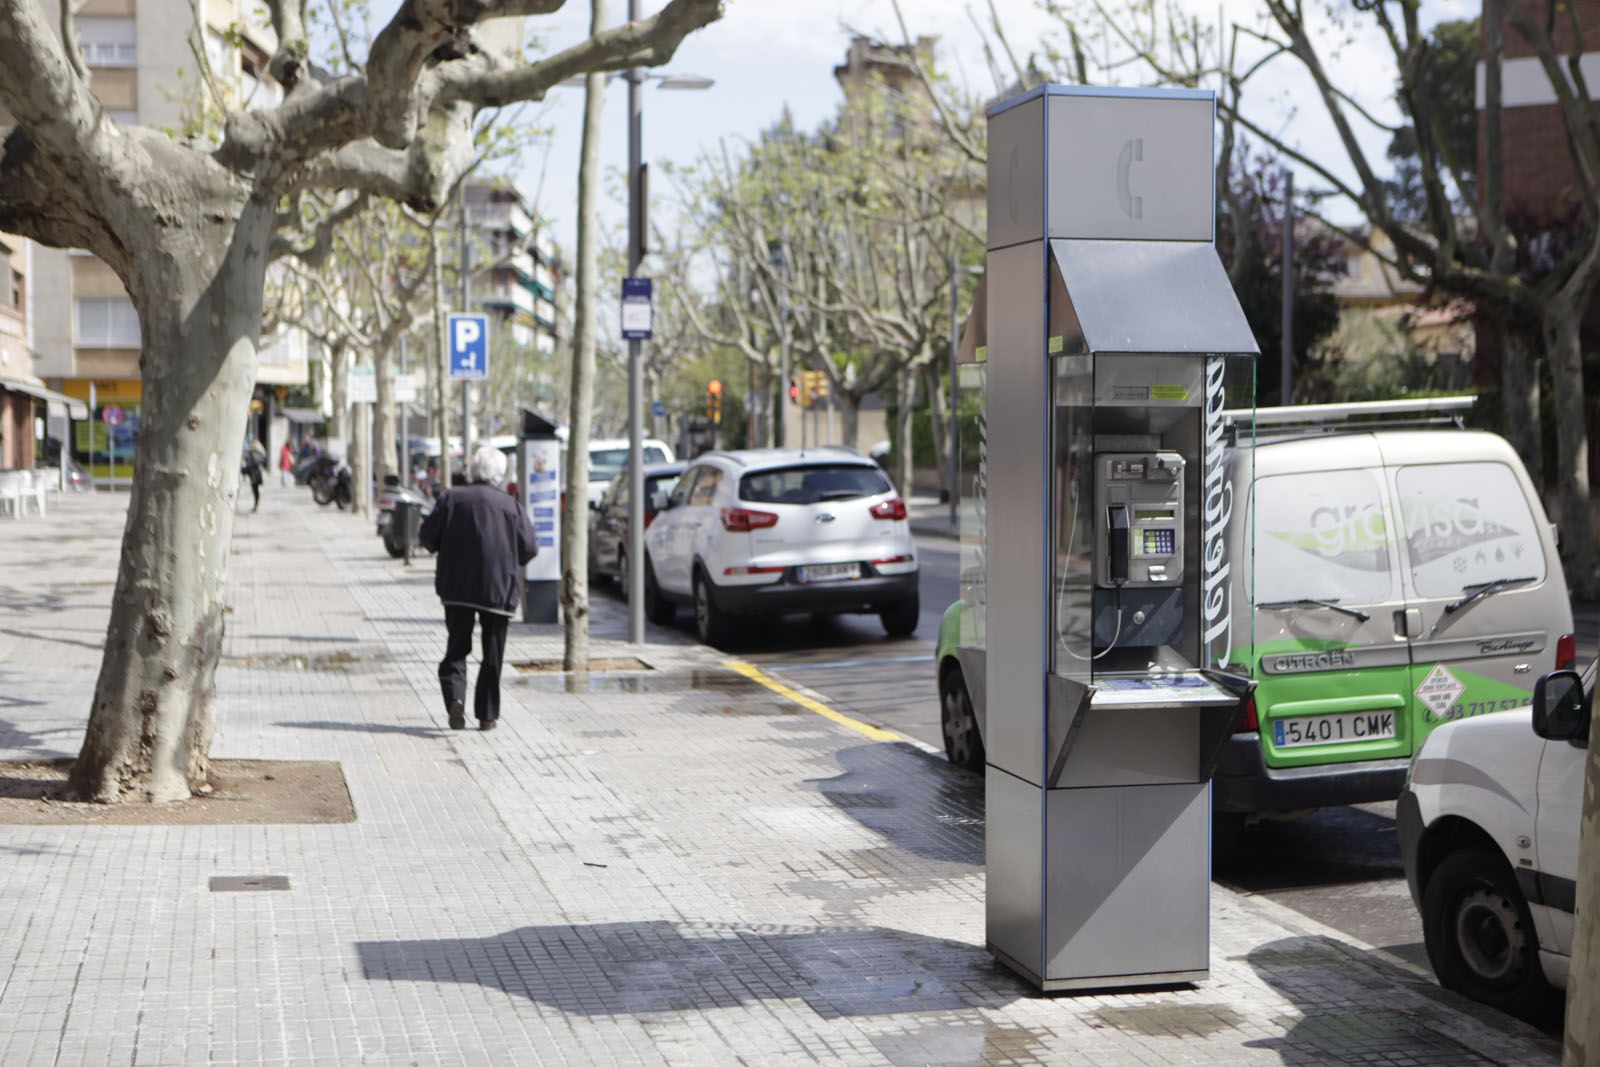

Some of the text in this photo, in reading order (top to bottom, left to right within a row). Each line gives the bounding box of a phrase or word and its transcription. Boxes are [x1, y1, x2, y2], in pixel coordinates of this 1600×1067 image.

[456, 320, 480, 352] P
[1468, 700, 1497, 717] 717
[1288, 713, 1393, 743] 5401 CMK
